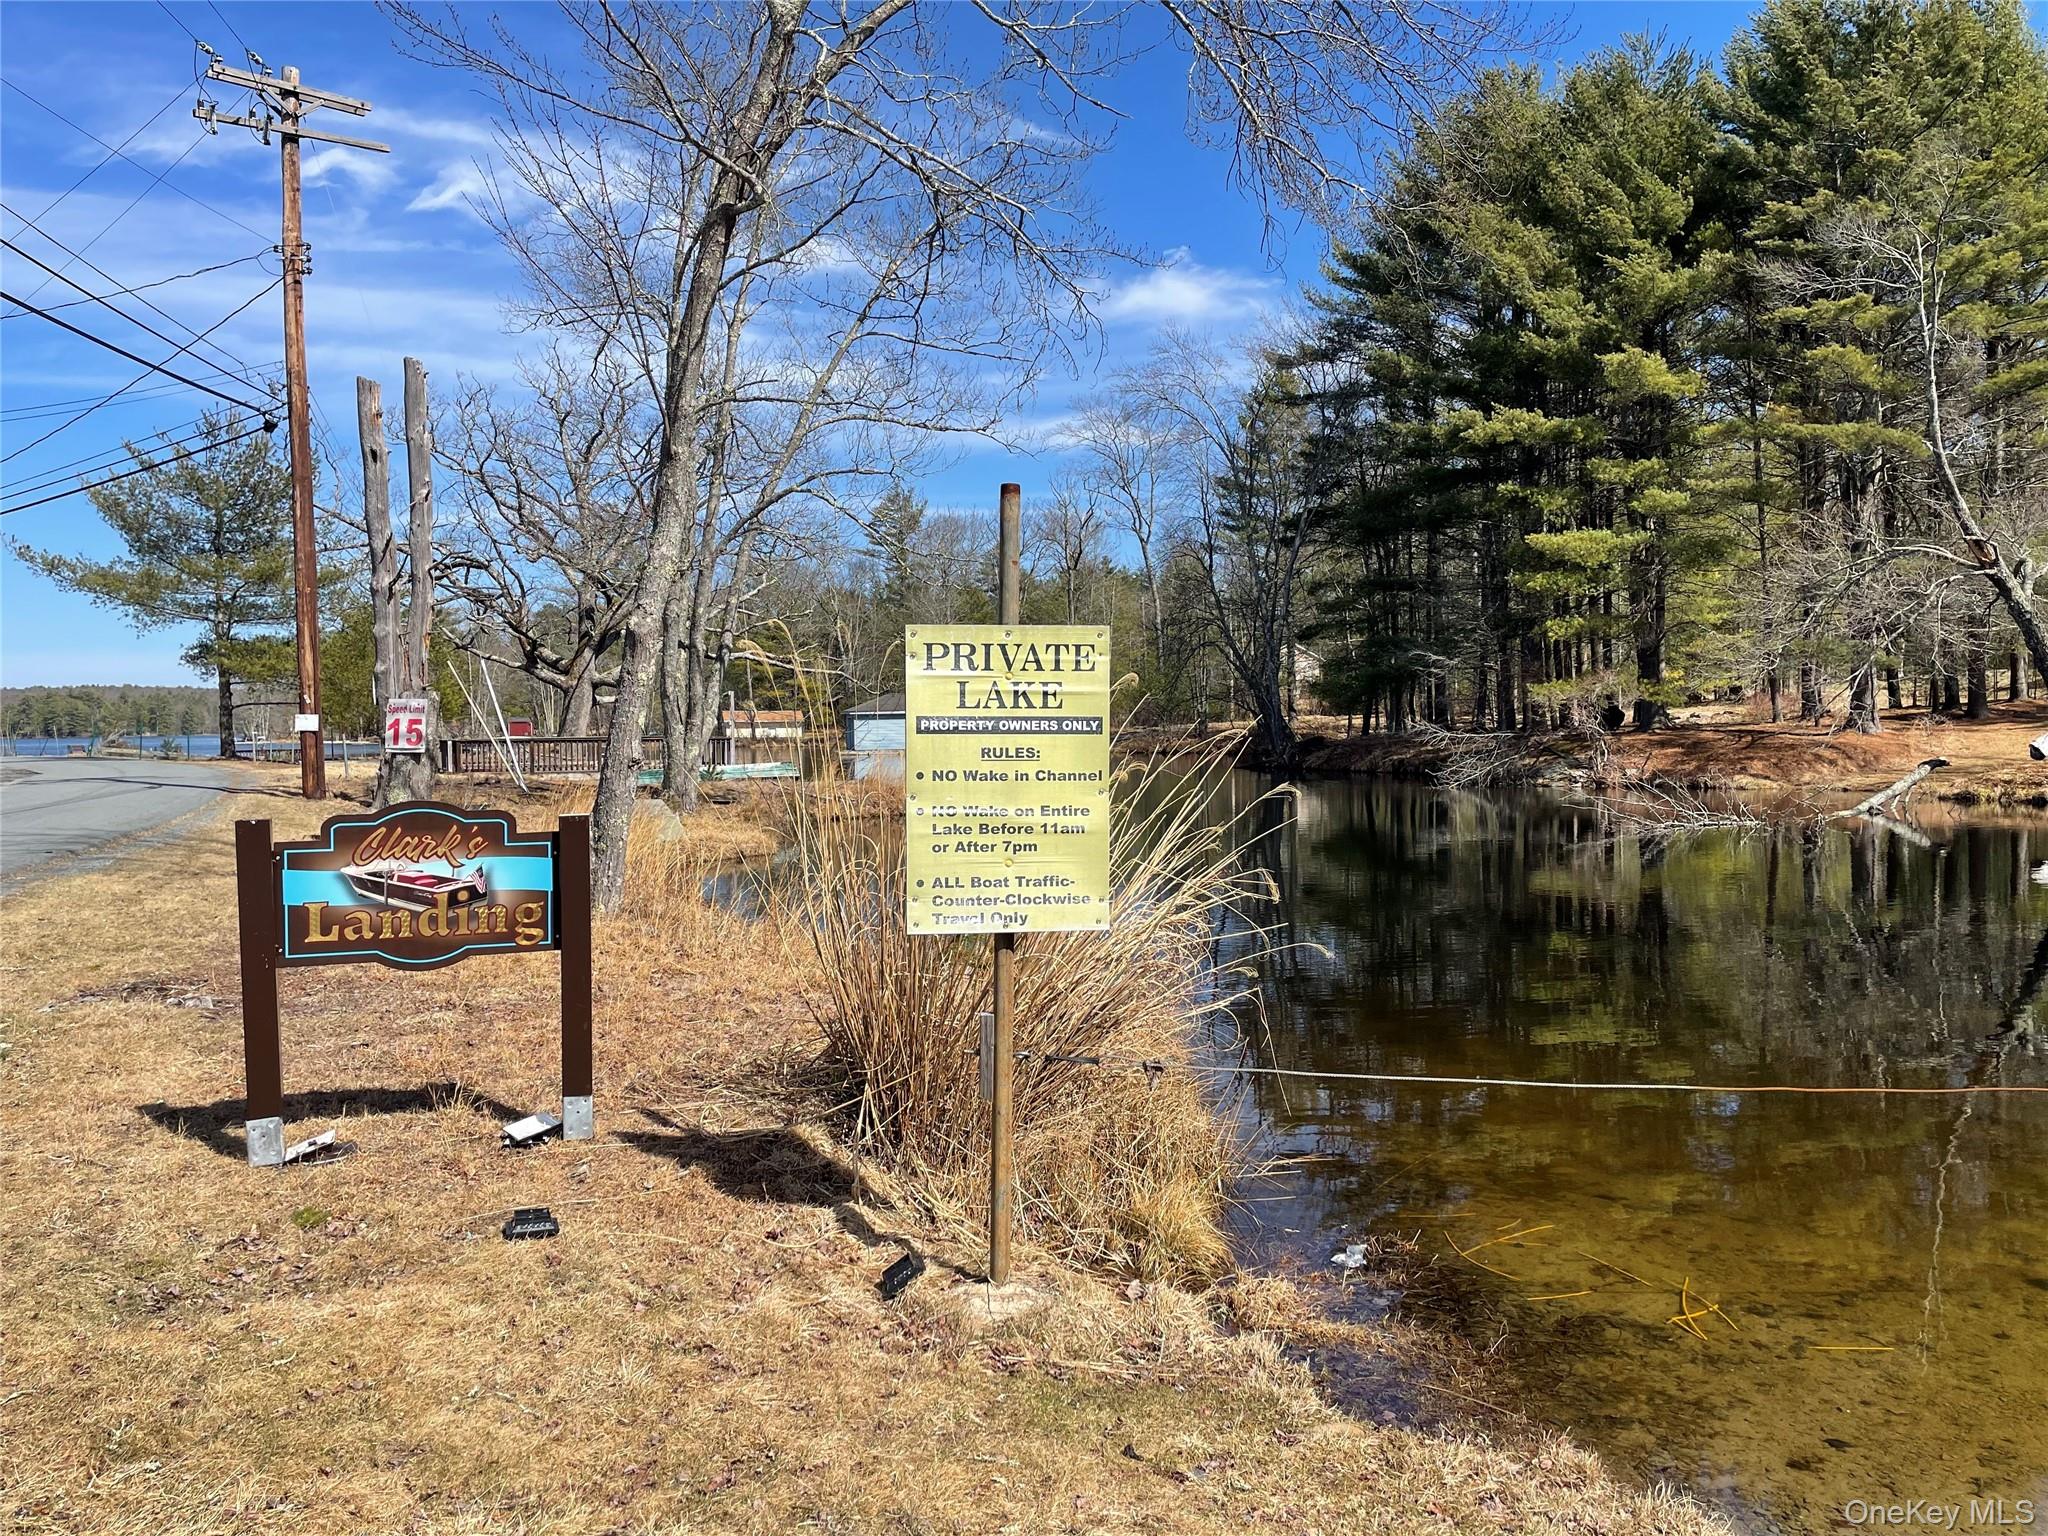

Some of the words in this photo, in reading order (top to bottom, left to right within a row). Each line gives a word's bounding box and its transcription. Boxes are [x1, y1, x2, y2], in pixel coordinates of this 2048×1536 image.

[923, 642, 1096, 672] PRIVATE
[956, 681, 1063, 709] LAKE
[387, 704, 408, 715] Speed
[409, 703, 425, 714] Limit
[387, 718, 424, 746] 15
[920, 720, 994, 732] PROPERTY
[999, 720, 1058, 731] OWNERS
[1063, 719, 1099, 732] ONLY
[981, 747, 1040, 760] RULES:
[932, 771, 957, 782] NO
[963, 770, 1009, 782] Wake
[1014, 770, 1030, 782] in
[1035, 770, 1103, 782] Channel
[932, 806, 957, 817] NO
[963, 806, 1009, 817] Wake
[1014, 808, 1035, 817] on
[1040, 806, 1090, 817] Entire
[932, 823, 973, 835] Lake
[978, 823, 1034, 835] Before
[1040, 823, 1086, 834] 11am
[353, 825, 489, 868] Clark's
[932, 844, 950, 853] or
[954, 841, 997, 853] After
[1002, 841, 1038, 855] 7pm
[932, 877, 965, 889] ALL
[970, 877, 1010, 888] Boat
[1015, 875, 1075, 887] Traffic-
[932, 893, 1091, 906] Counter-Clockwise
[303, 890, 545, 947] Landing
[932, 912, 985, 925] Travel
[990, 911, 1029, 926] Only
